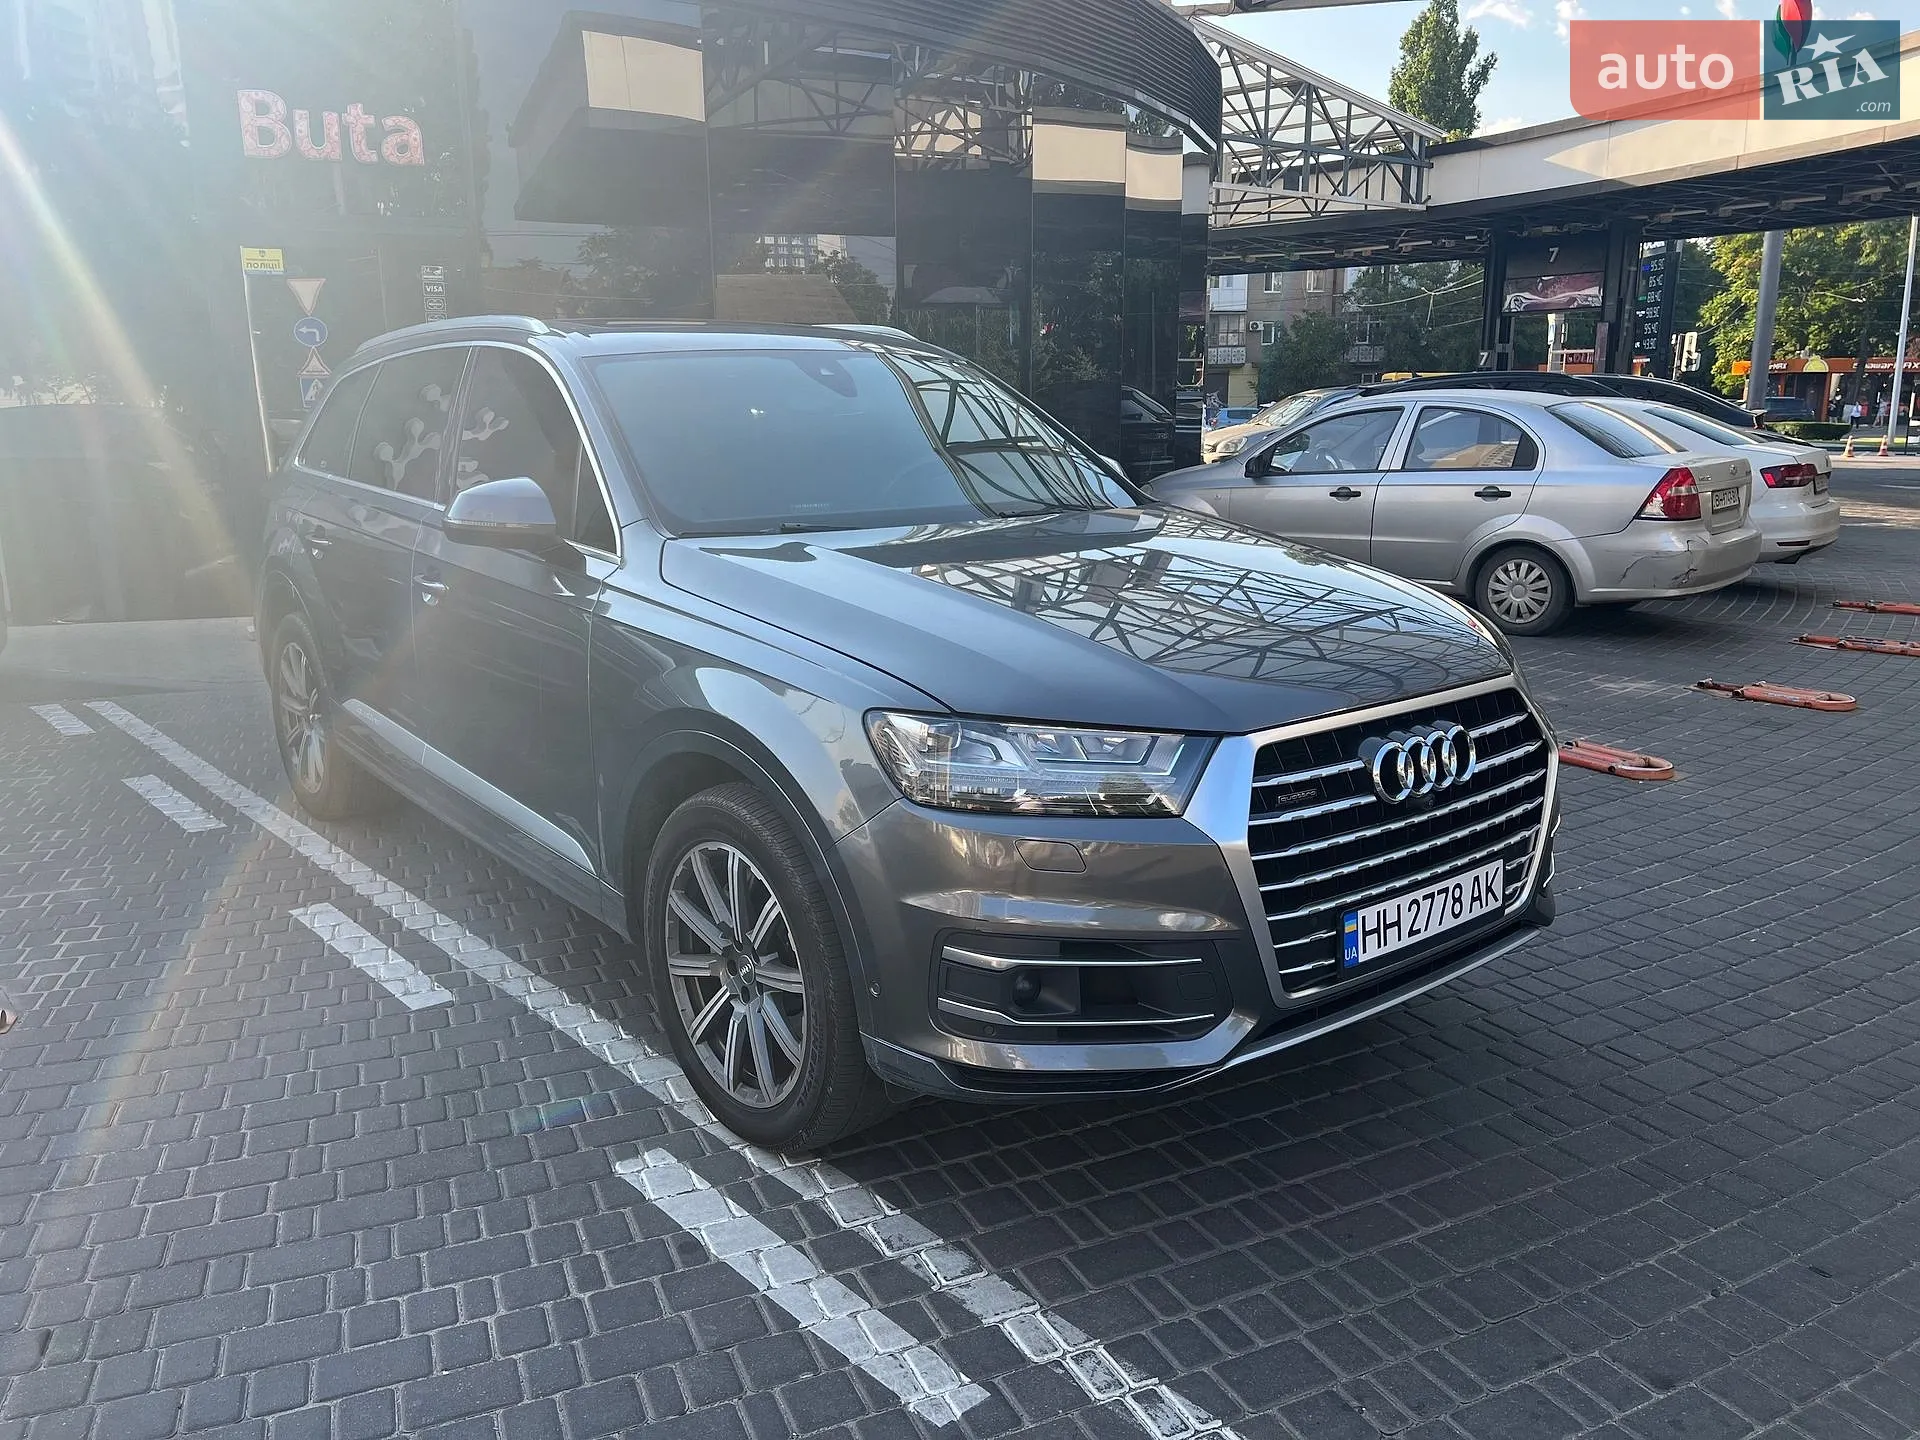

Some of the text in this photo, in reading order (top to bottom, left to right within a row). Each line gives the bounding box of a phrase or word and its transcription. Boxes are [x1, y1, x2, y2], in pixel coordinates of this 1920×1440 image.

[237, 89, 425, 166] Buta
[1548, 247, 1560, 263] 7
[425, 285, 443, 293] VISA
[1479, 352, 1490, 366] 7
[1361, 866, 1500, 955] HH 2778 AK
[1344, 947, 1357, 961] UA
